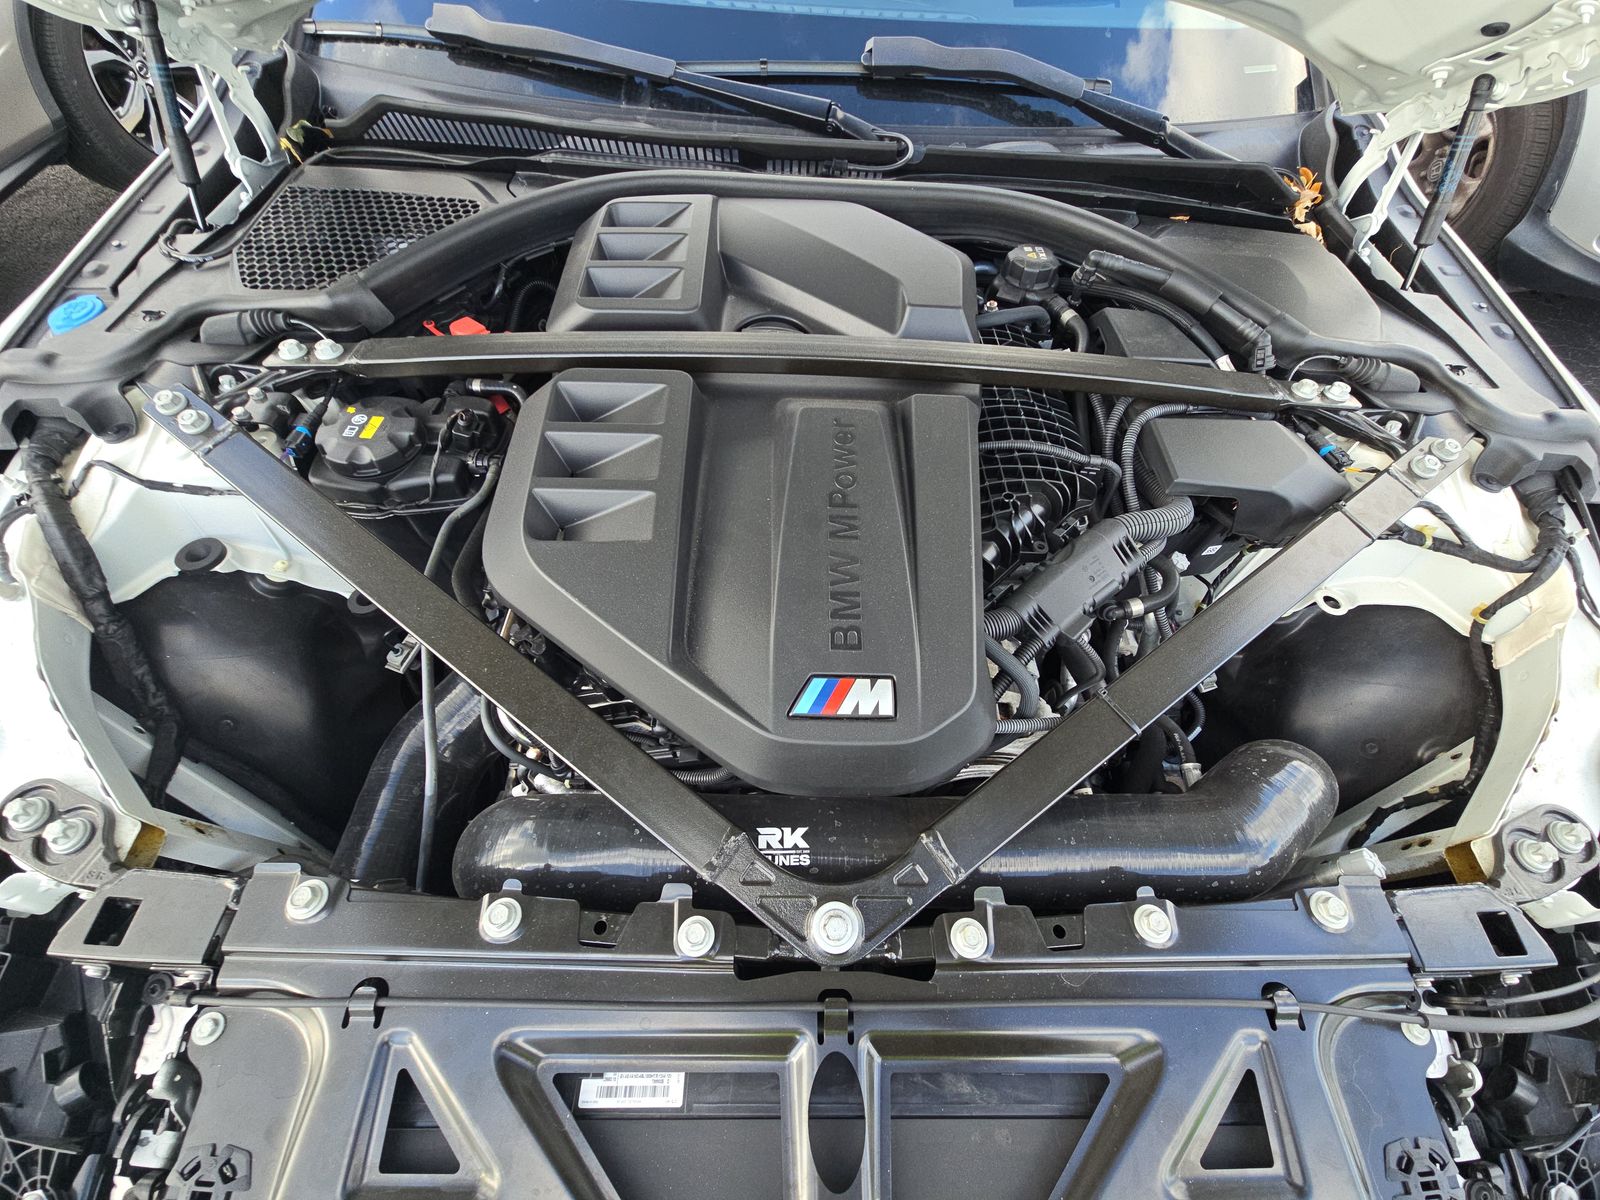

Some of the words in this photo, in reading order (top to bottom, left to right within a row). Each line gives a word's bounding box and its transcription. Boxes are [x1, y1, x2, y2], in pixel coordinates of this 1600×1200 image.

[829, 551, 862, 652] BMW
[836, 678, 895, 716] M
[756, 827, 810, 849] RK
[764, 854, 811, 866] UNES
